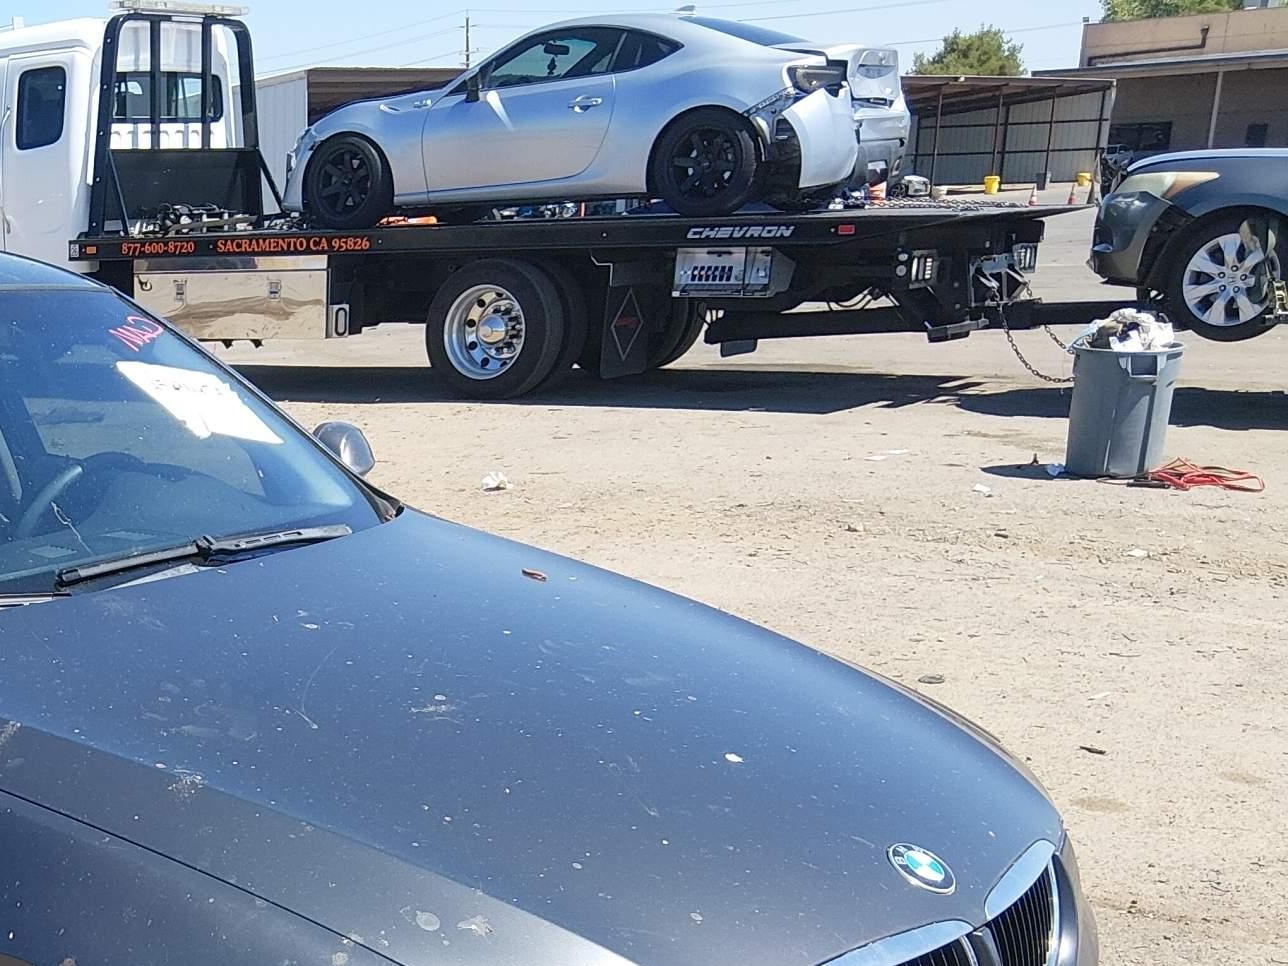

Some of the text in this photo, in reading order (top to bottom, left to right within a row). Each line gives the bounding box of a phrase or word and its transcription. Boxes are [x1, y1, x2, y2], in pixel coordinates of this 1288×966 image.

[686, 226, 795, 239] CHEVRON
[121, 237, 371, 256] 877-600-8720 SACRAMENTO CA 95826
